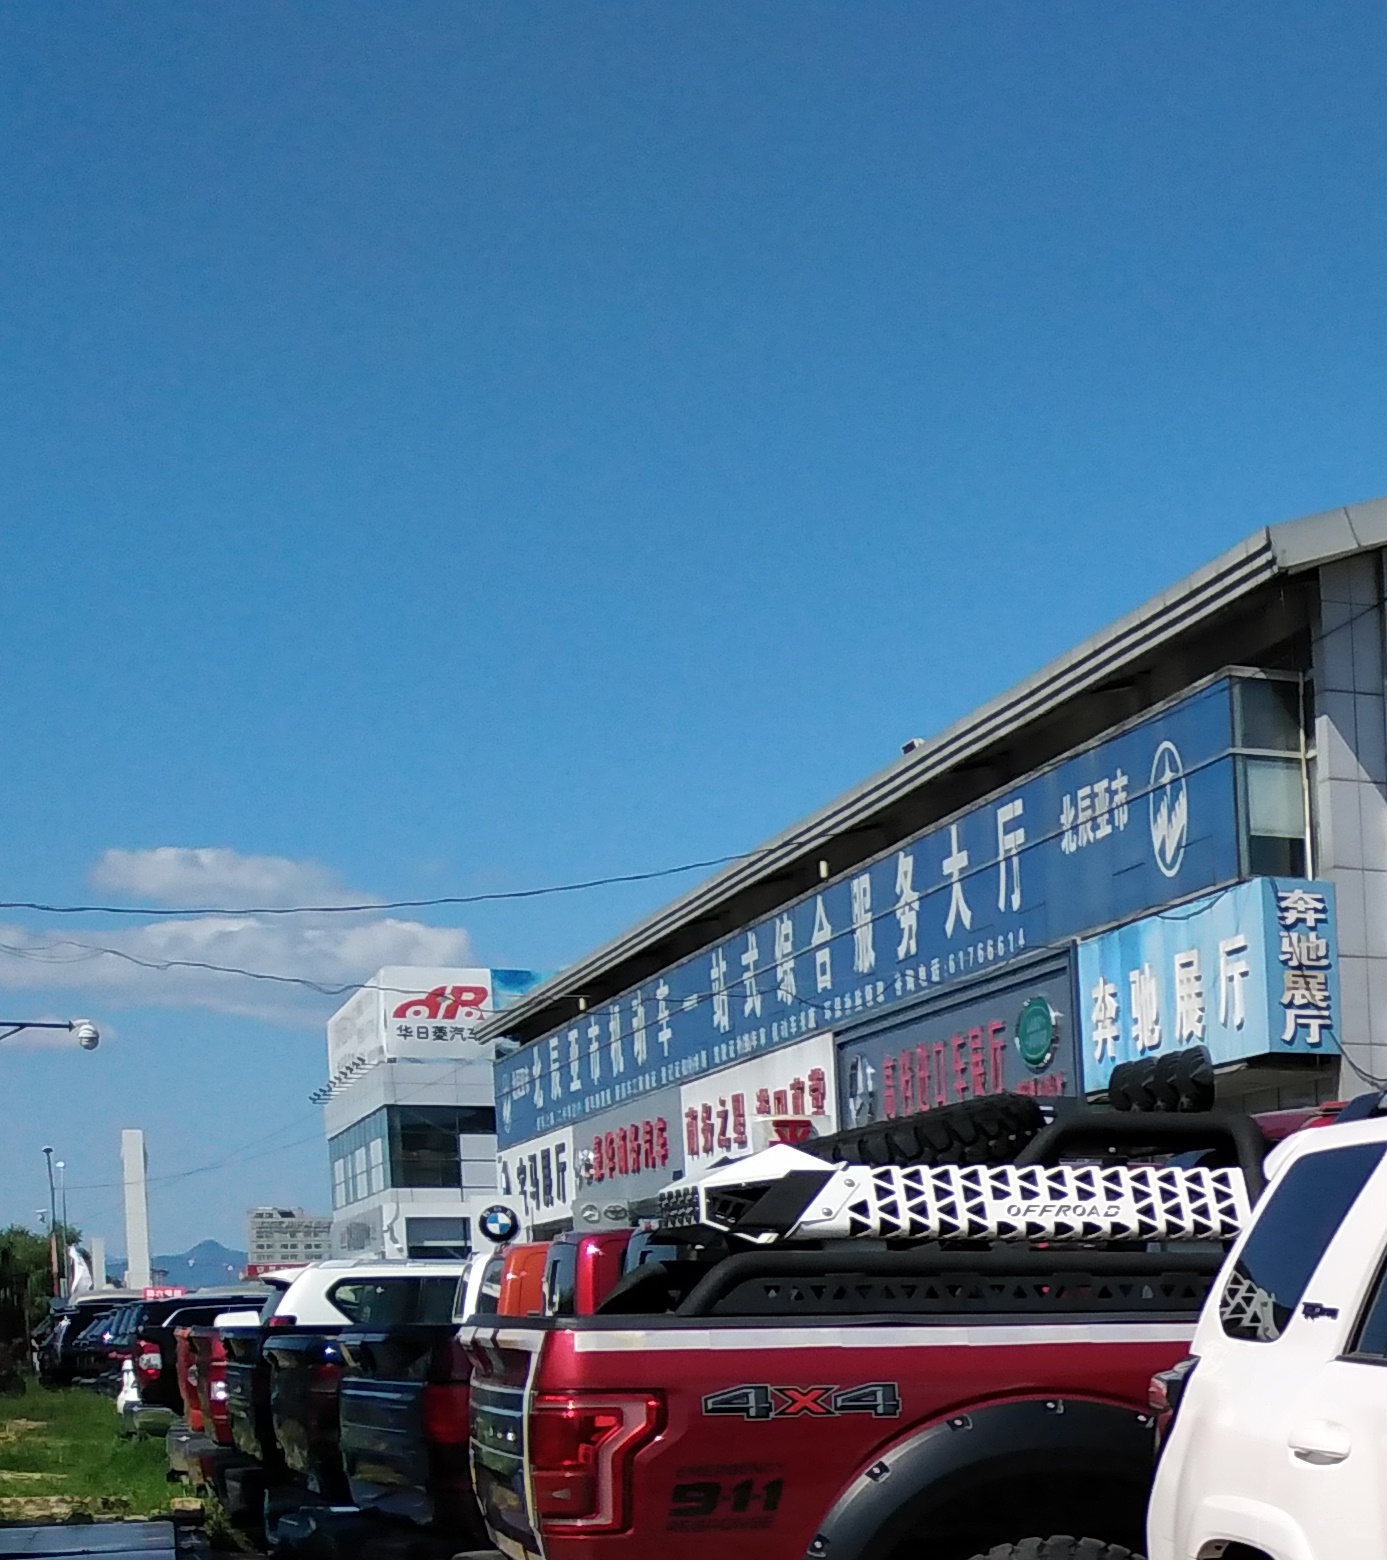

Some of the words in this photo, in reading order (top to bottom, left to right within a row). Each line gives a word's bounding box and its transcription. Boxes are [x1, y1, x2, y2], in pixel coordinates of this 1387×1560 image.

[1059, 768, 1130, 854] 北辰亚市
[1091, 933, 1251, 1064] 奔驰展厅
[1278, 888, 1332, 1046] 奔驰展厅
[1006, 1204, 1121, 1218] OFFROAD
